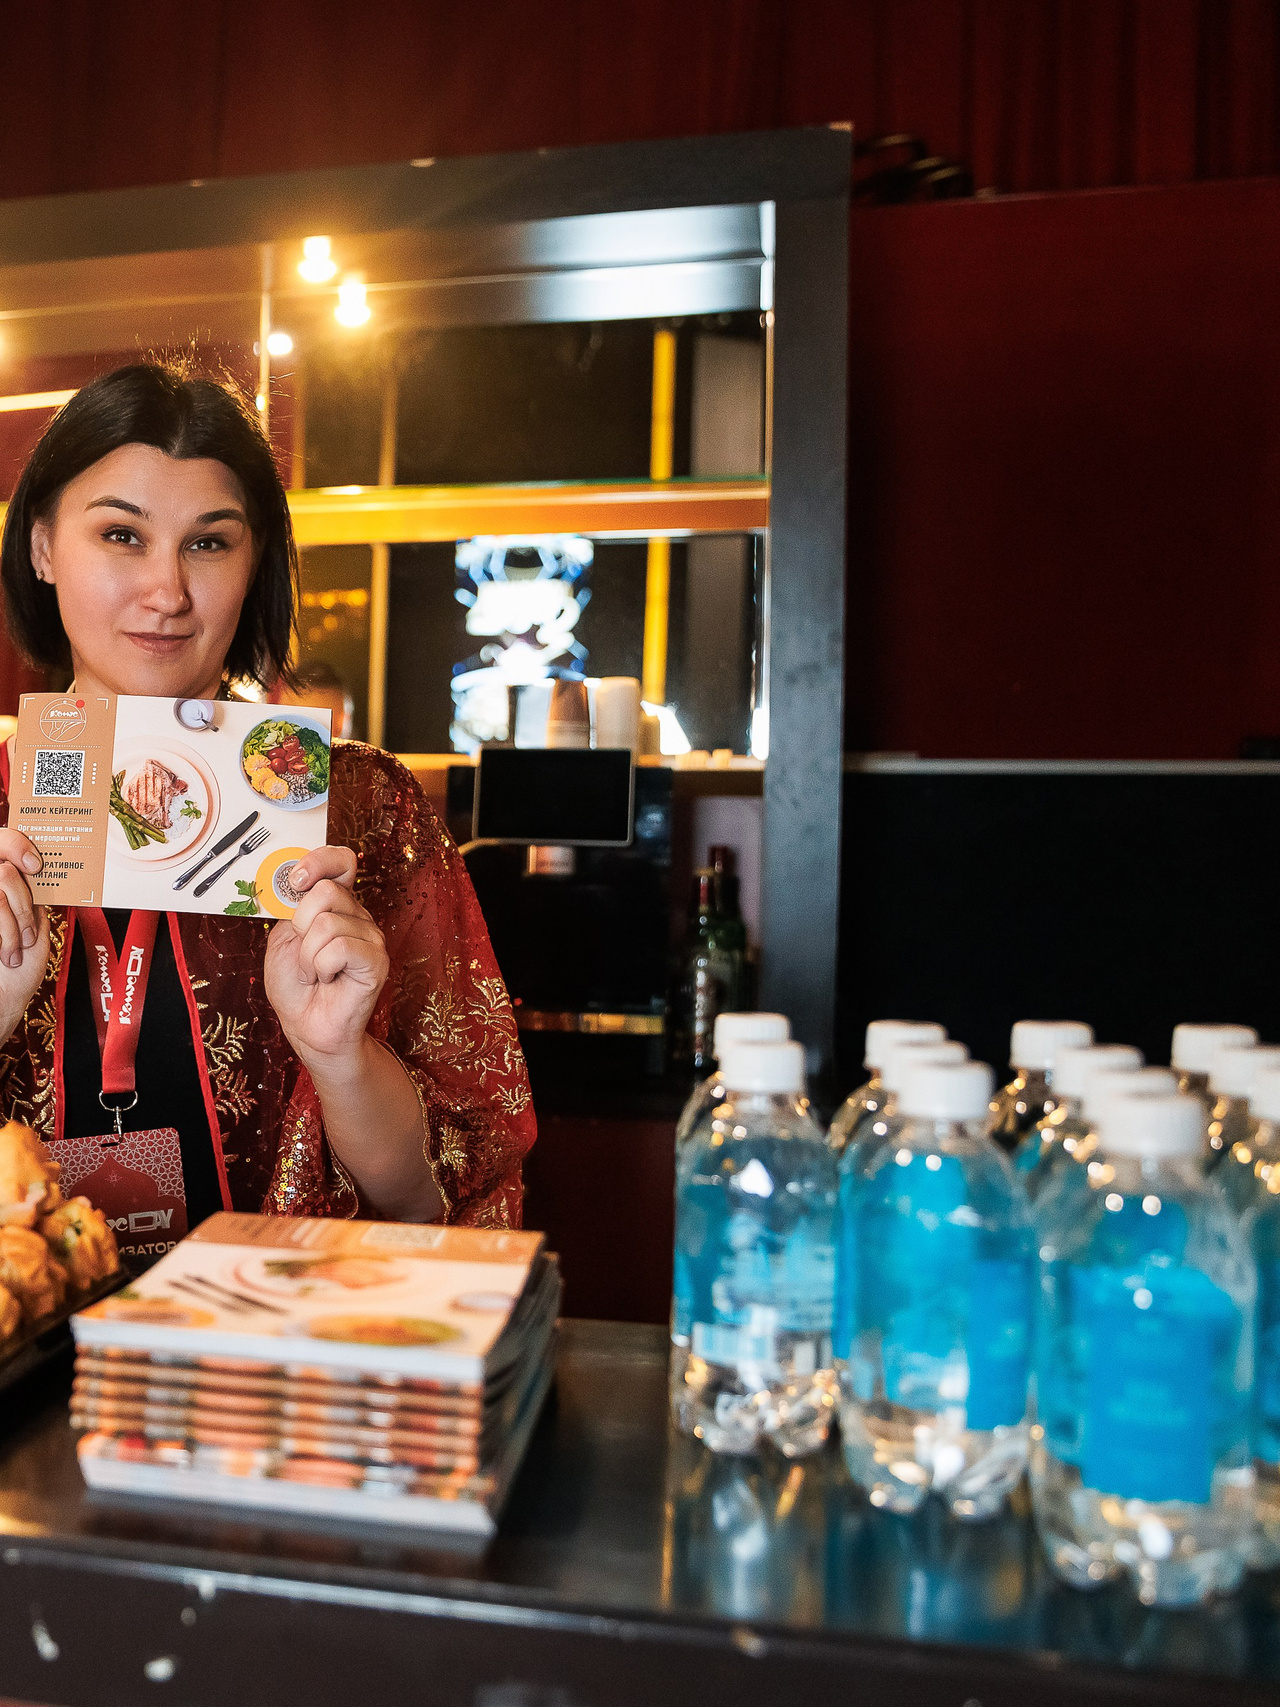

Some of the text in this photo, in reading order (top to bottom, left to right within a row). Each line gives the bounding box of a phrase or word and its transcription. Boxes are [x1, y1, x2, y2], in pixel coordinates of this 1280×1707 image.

[20, 806, 93, 815] КОМУС КЕЙТЕРИНГ
[17, 824, 63, 833] Организация
[35, 834, 80, 843] мероприятий
[44, 861, 84, 870] РАТИВНОЕ
